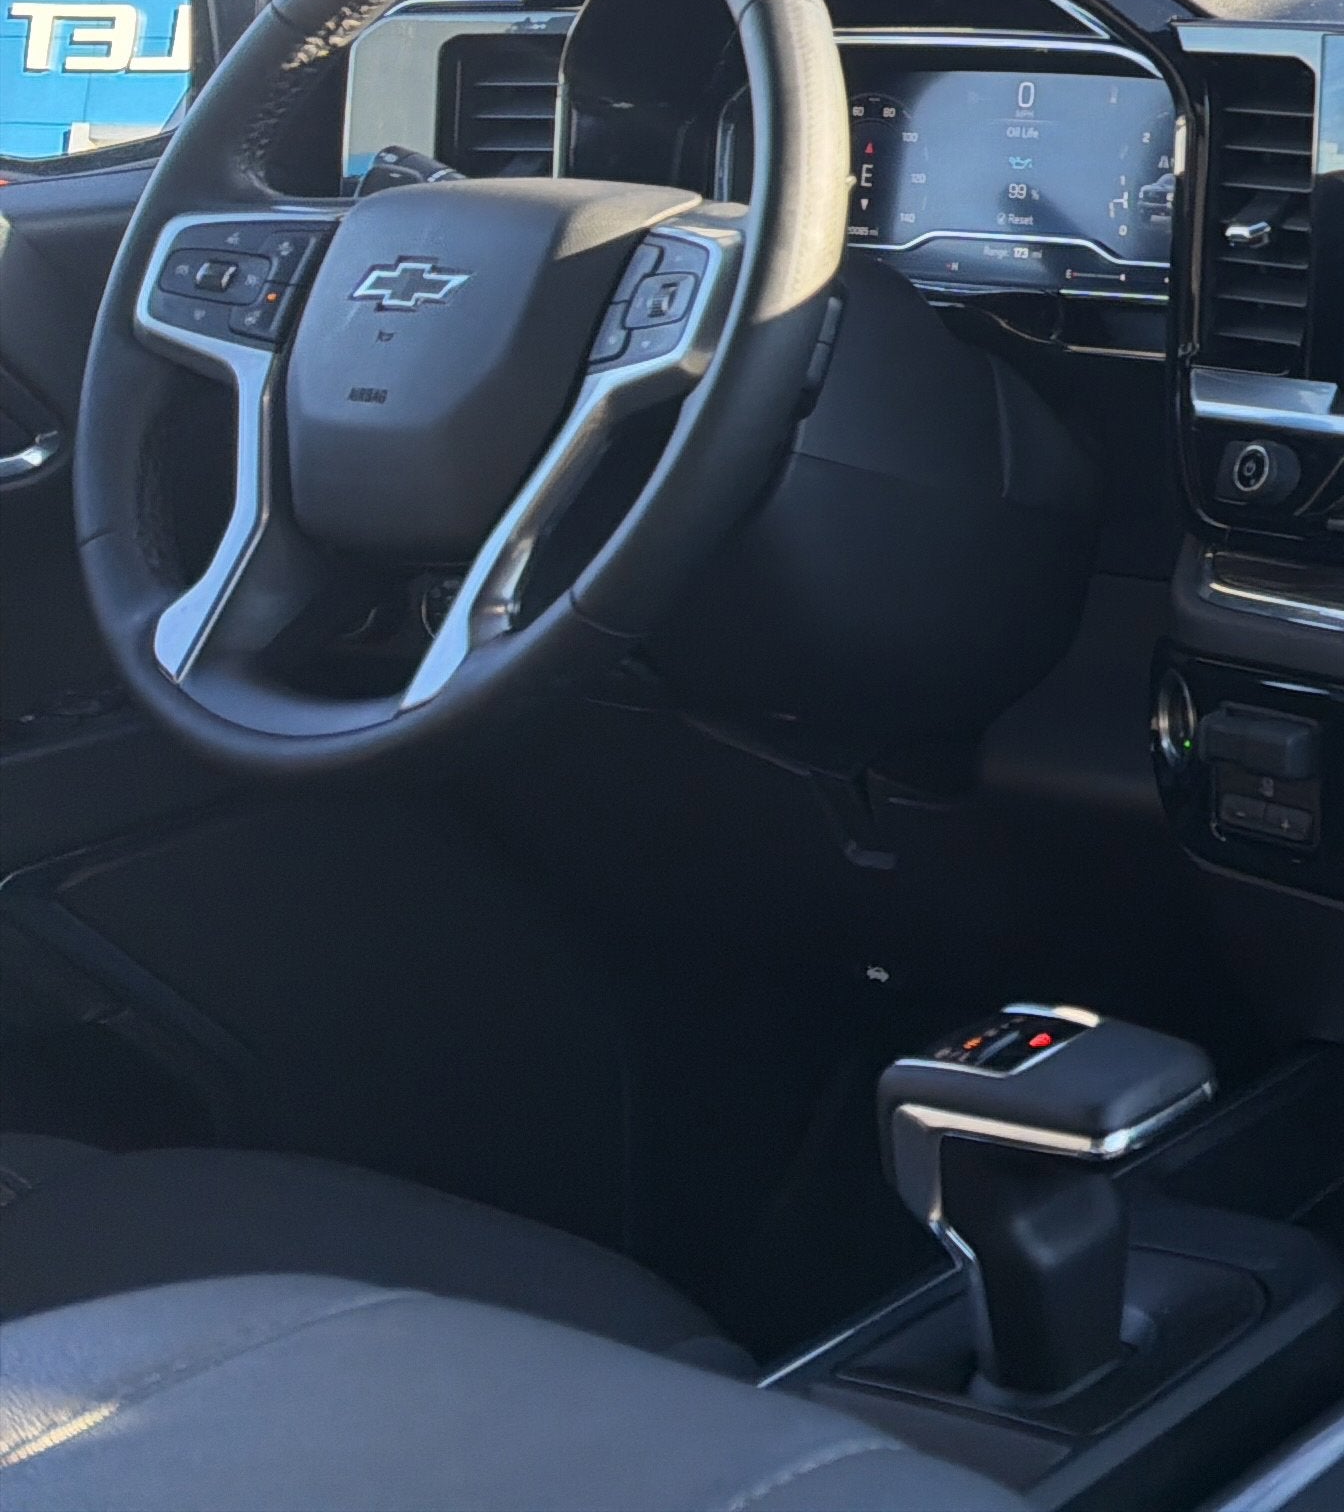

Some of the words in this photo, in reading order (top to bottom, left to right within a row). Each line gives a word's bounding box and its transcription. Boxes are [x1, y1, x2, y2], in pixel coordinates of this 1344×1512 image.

[1018, 81, 1035, 108] 0
[883, 107, 896, 118] 80
[1006, 126, 1020, 138] Oil
[1021, 126, 1039, 139] Life
[1141, 131, 1151, 143] 2
[860, 163, 874, 187] E
[1008, 183, 1027, 199] 99
[1007, 213, 1034, 226] Reset
[1118, 224, 1128, 236] 0
